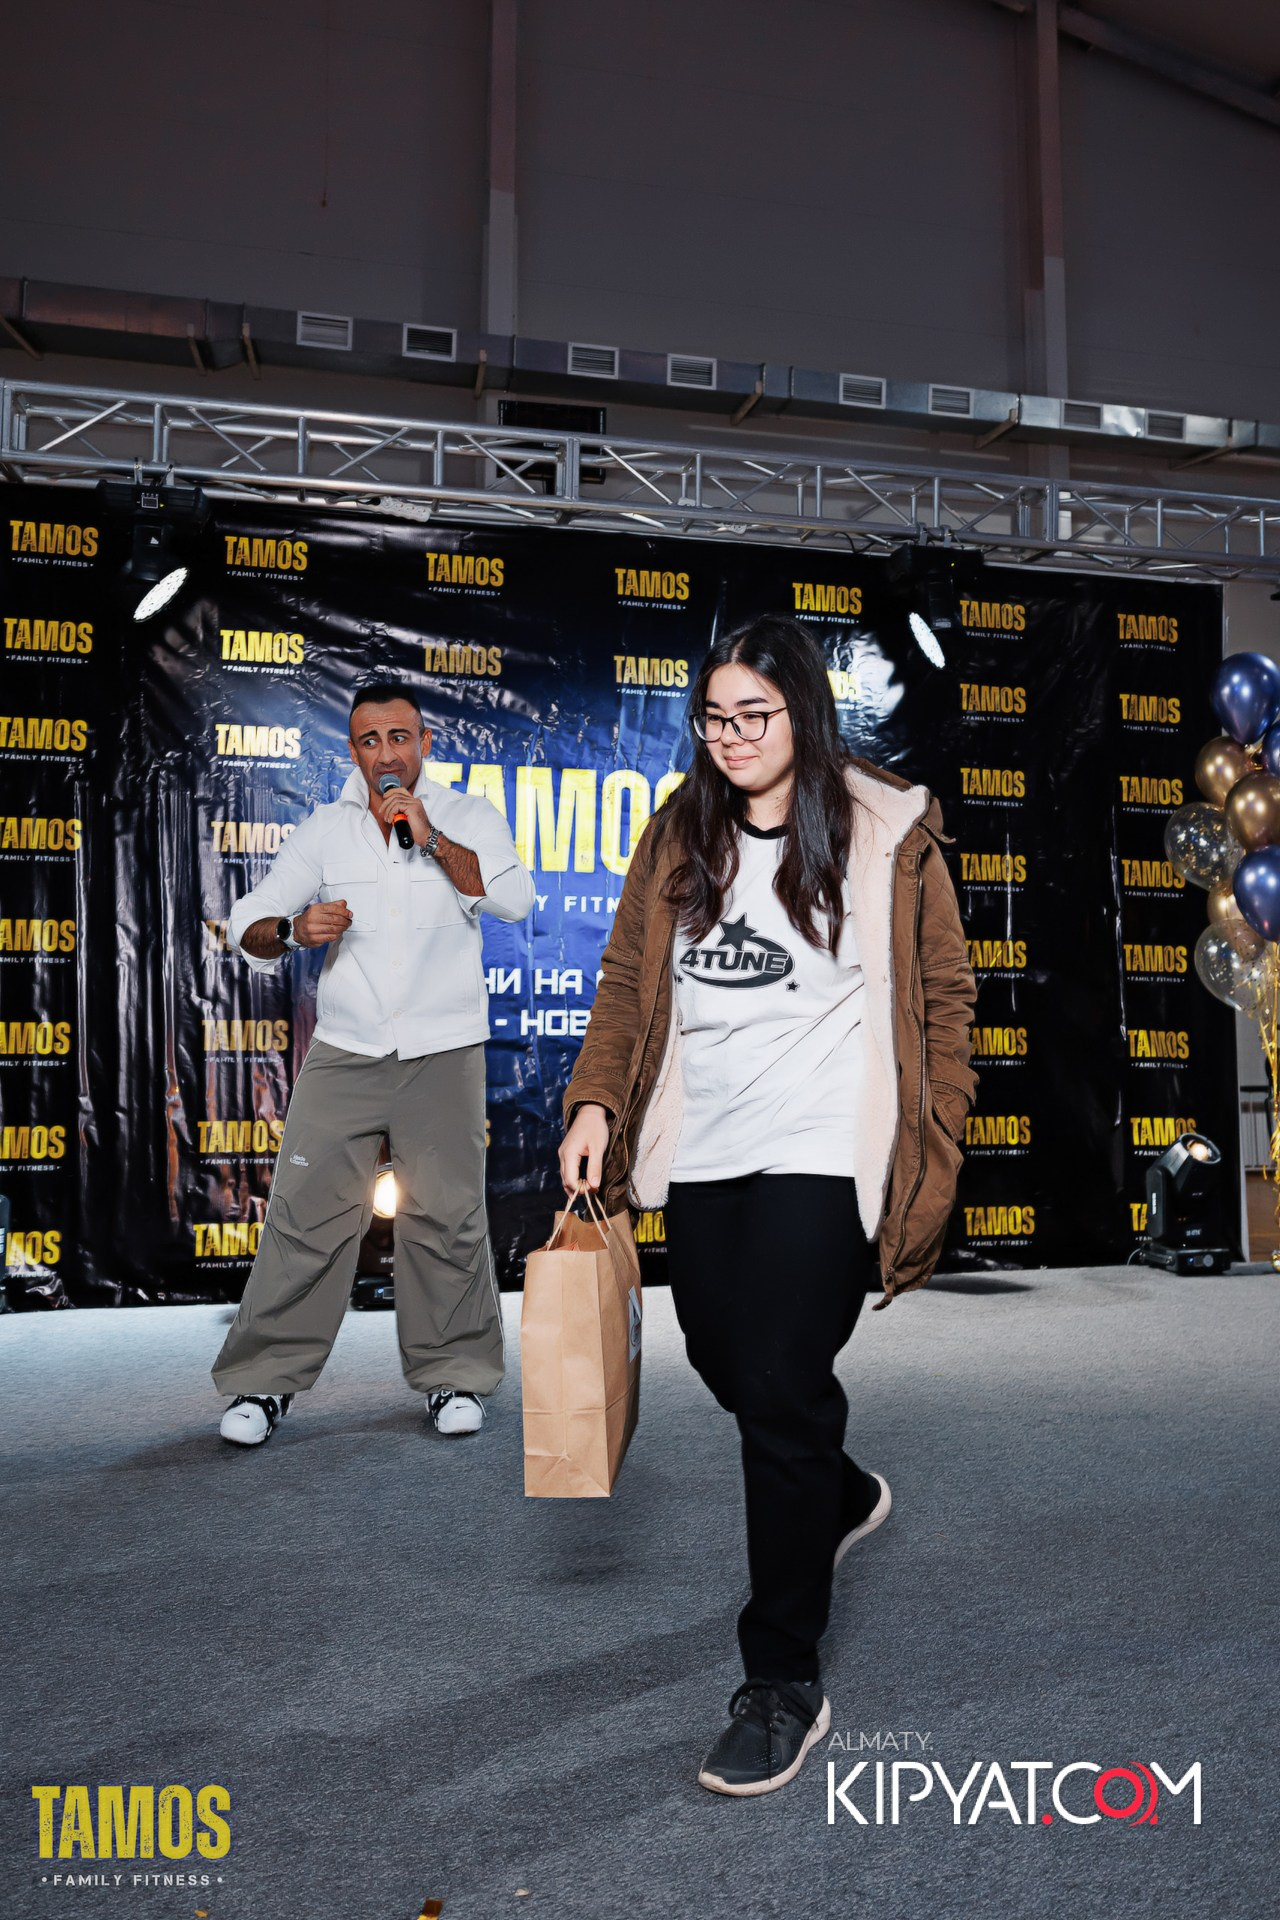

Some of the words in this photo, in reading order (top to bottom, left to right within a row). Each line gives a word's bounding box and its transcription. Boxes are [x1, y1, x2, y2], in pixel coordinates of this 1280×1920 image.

[10, 520, 98, 556] TAMOS
[17, 557, 49, 565] FAMILY
[225, 536, 308, 571] TAMOS
[232, 570, 261, 578] FAMILY
[266, 573, 299, 581] FITNESS
[426, 552, 504, 587] TAMOS
[615, 568, 689, 600] TAMOS
[433, 586, 461, 594] FAMILY
[465, 588, 496, 596] FITNESS
[622, 600, 649, 608] FAMILY
[792, 582, 862, 615] TAMOS
[799, 614, 825, 622] FAMILY
[960, 600, 1026, 631] TAMOS
[1118, 613, 1178, 643] TAMOS
[4, 618, 93, 653] TAMOS
[220, 629, 304, 664] TAMOS
[11, 655, 45, 663] FAMILY
[227, 665, 258, 673] FAMILY
[261, 667, 295, 675] FITNESS
[423, 644, 502, 676] TAMOS
[613, 655, 689, 688] TAMOS
[651, 690, 681, 698] FITNESS
[960, 683, 1026, 714] TAMOS
[1120, 694, 1180, 724] TAMOS
[0, 717, 87, 751] TAMOS
[215, 724, 301, 759] TAMOS
[222, 760, 254, 768] FAMILY
[257, 761, 291, 769] FITNESS
[960, 767, 1025, 797] TAMOS
[1120, 776, 1183, 805] TAMOS
[960, 853, 1026, 882] TAMOS
[1121, 859, 1185, 889] TAMOS
[564, 896, 621, 913] FITN
[0, 919, 76, 952] AMOS
[680, 948, 788, 974] 4TUNE
[1123, 944, 1187, 973] TAMOS
[534, 968, 583, 995] НА
[0, 1021, 71, 1055] MOS
[202, 1019, 289, 1051] TAMOS
[971, 1027, 1027, 1055] AMOS
[1127, 1030, 1189, 1059] TAMOS
[0, 1125, 66, 1159] MOS
[197, 1120, 285, 1153] TAMOS
[965, 1116, 1031, 1145] TAMOS
[964, 1205, 1035, 1236] TAMOS
[5, 1230, 61, 1267] MOS
[193, 1222, 266, 1257] TAMO
